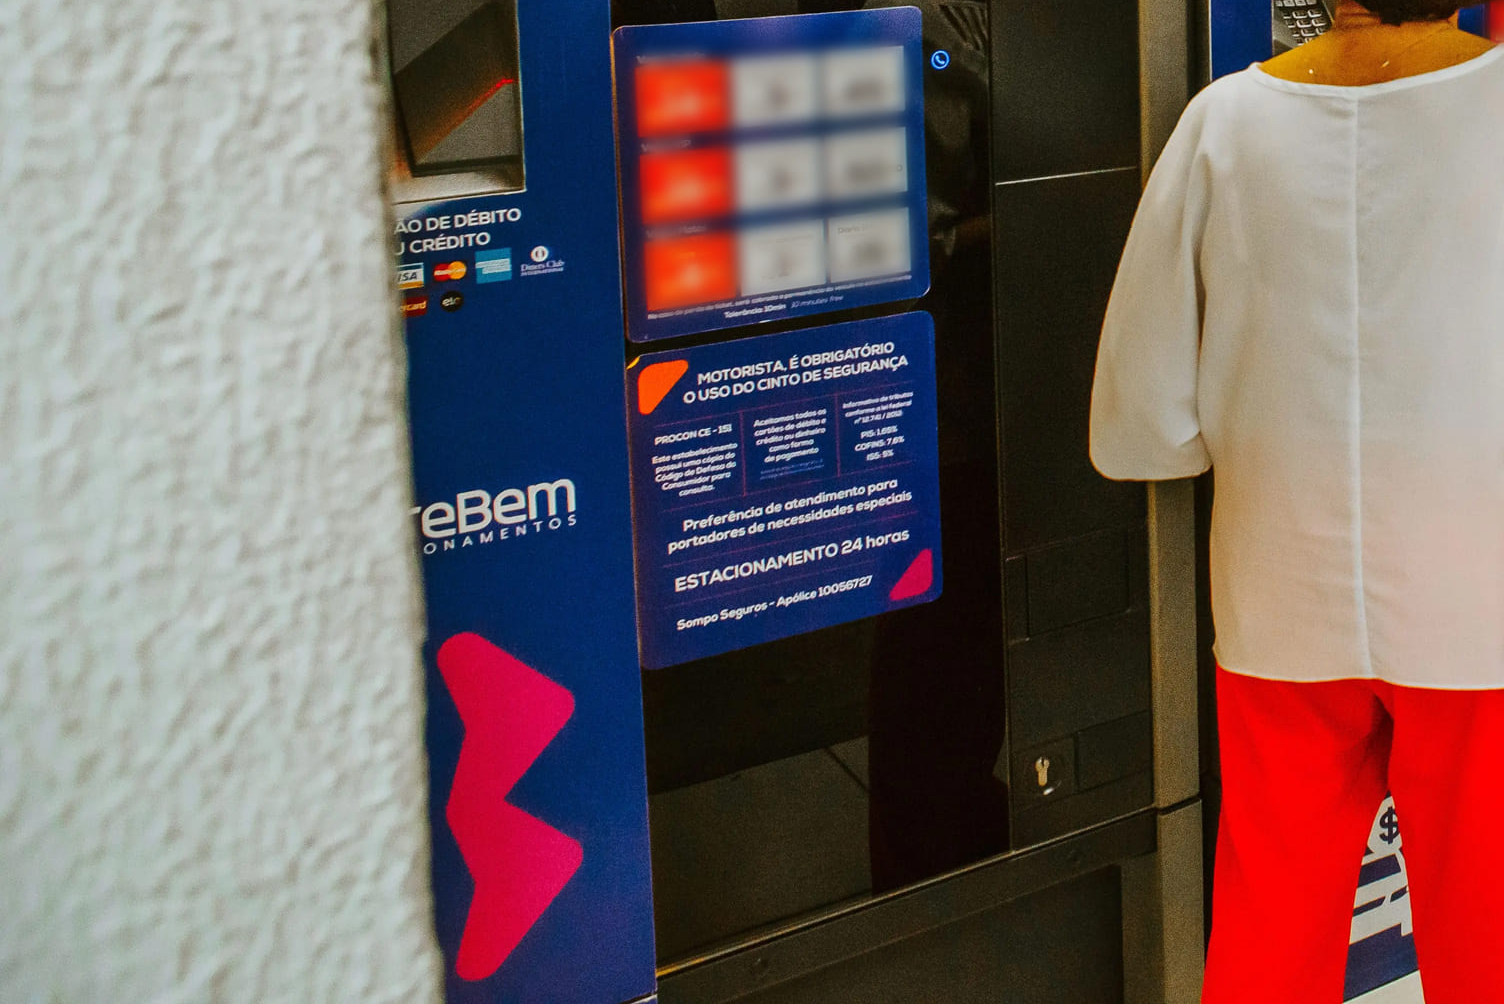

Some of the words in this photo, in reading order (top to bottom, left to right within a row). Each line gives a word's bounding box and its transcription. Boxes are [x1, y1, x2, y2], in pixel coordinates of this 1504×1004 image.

[425, 216, 451, 232] DE
[454, 208, 522, 228] DÉBITO
[409, 232, 491, 254] CRÉDITO
[683, 391, 696, 404] O
[698, 384, 731, 402] USO
[733, 379, 755, 395] DO
[756, 372, 801, 392] CINTO
[802, 368, 823, 384] DE
[823, 354, 908, 381] SEGURANÇA
[697, 359, 788, 385] MOTORISTA,
[789, 354, 800, 370] É
[800, 341, 895, 368] OBRIGATÓRIO
[795, 410, 817, 421] todos
[654, 431, 697, 446] PROCON
[698, 428, 712, 438] CE
[684, 468, 695, 477] de
[711, 471, 731, 483] para
[409, 478, 577, 539] eBem
[667, 526, 746, 555] portadores
[748, 520, 765, 534] de
[767, 502, 855, 530] necessidades
[855, 490, 913, 513] especiais
[683, 505, 764, 533] Preferência
[765, 501, 782, 515] de
[784, 484, 866, 511] atendimento
[867, 478, 898, 497] para
[423, 514, 578, 555] ONAMENTOS
[674, 542, 839, 592] ESTACIONAMENTO
[841, 536, 863, 552] 24
[865, 529, 910, 549] horas
[676, 613, 719, 631] Sompo
[719, 601, 768, 621] Seguros
[776, 590, 818, 609] Apólice
